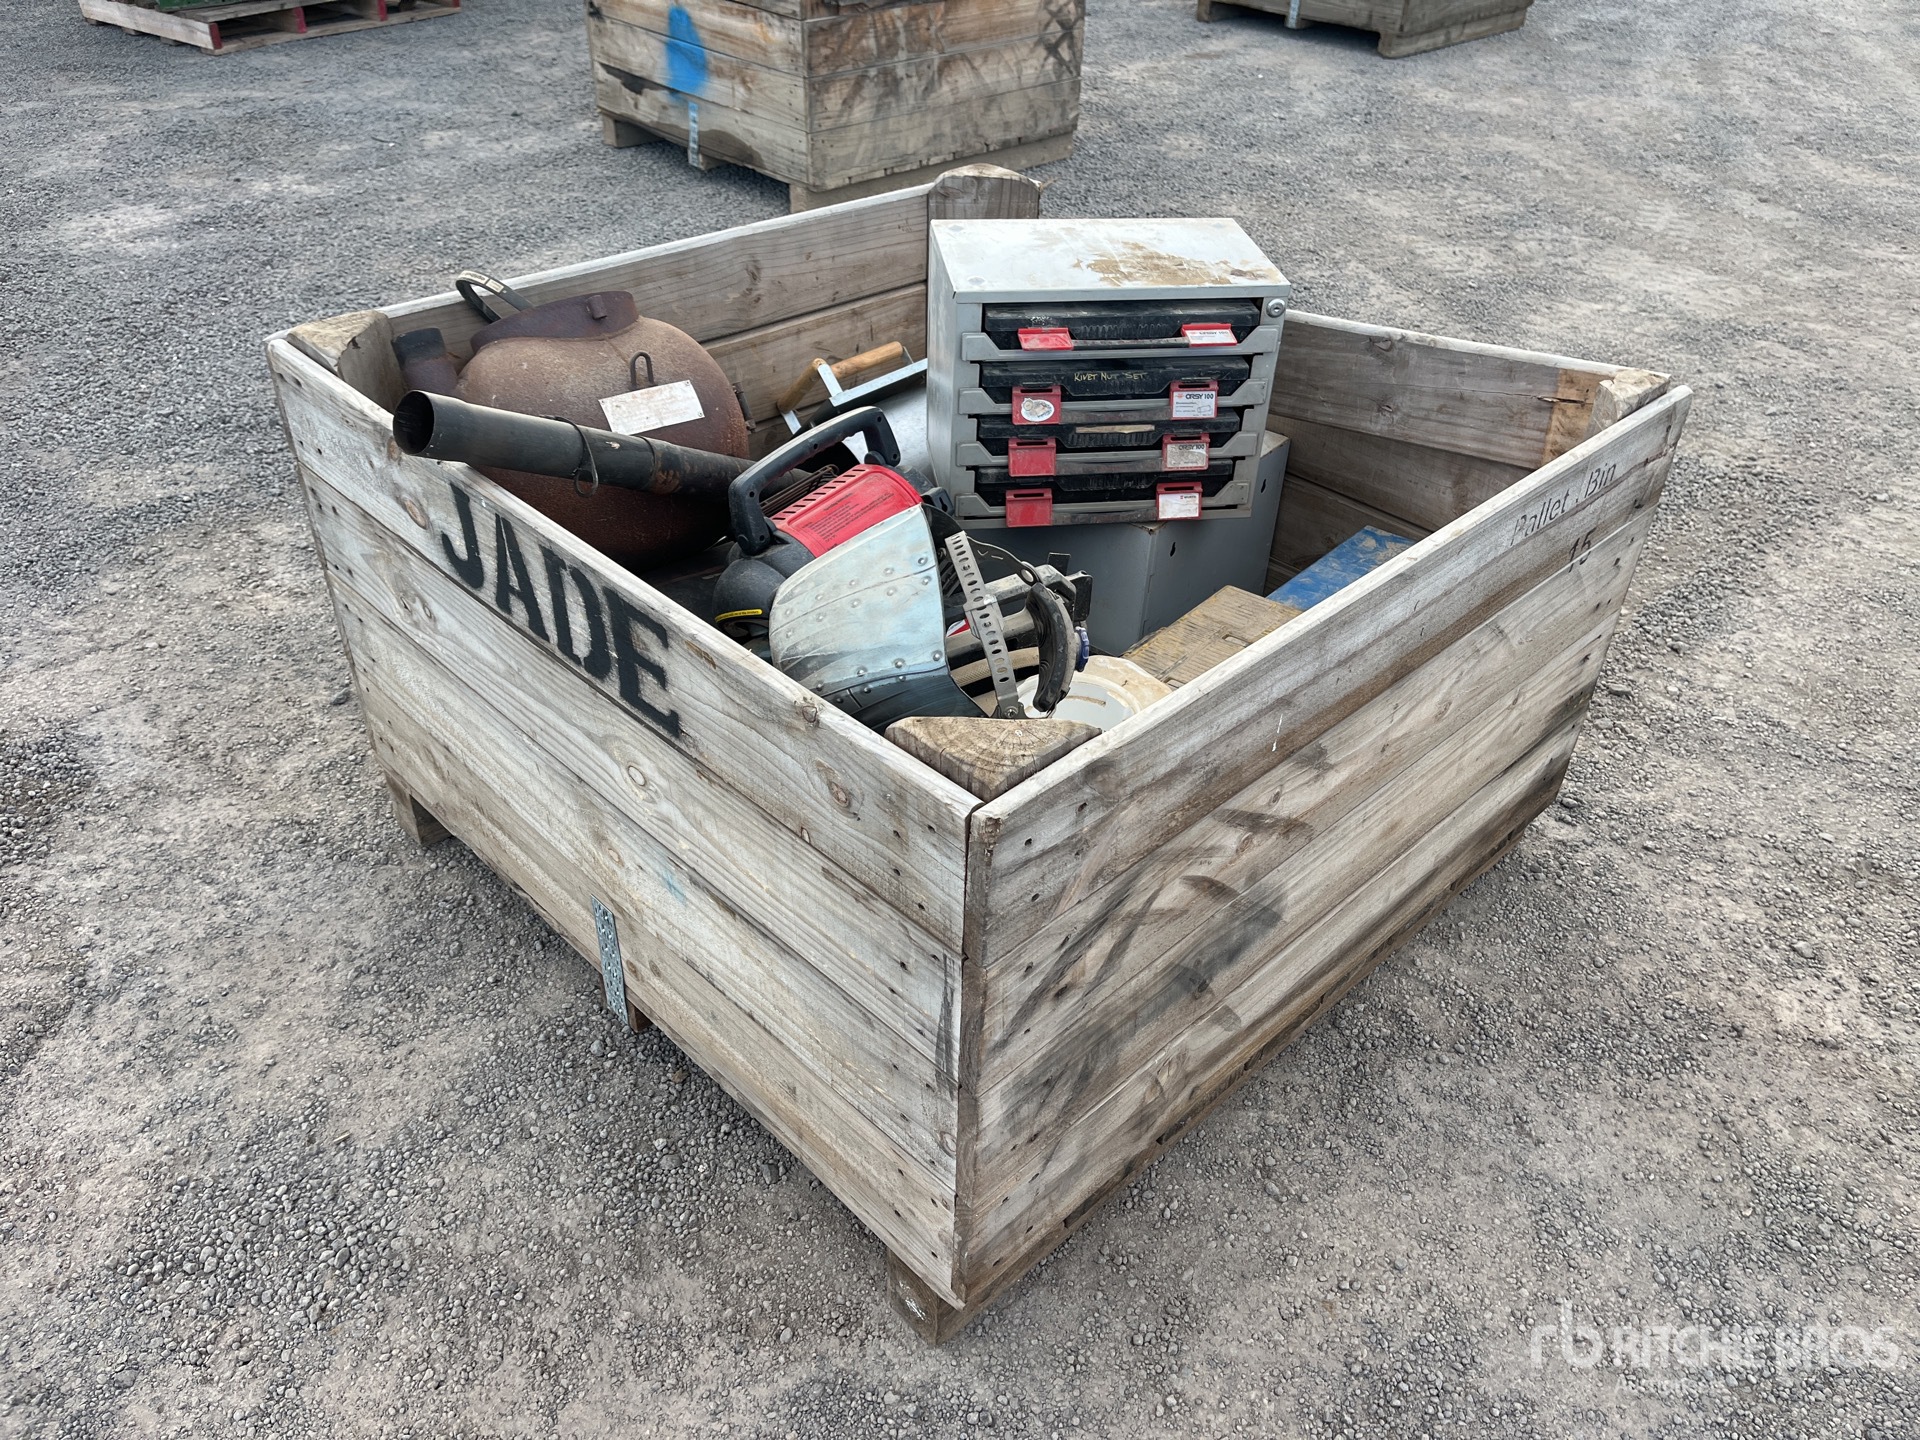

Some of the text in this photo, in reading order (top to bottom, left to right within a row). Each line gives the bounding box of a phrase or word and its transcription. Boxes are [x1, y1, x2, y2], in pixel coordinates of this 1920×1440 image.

[1122, 371, 1148, 381] SET
[1584, 462, 1617, 499] Bin
[441, 483, 682, 738] JADE
